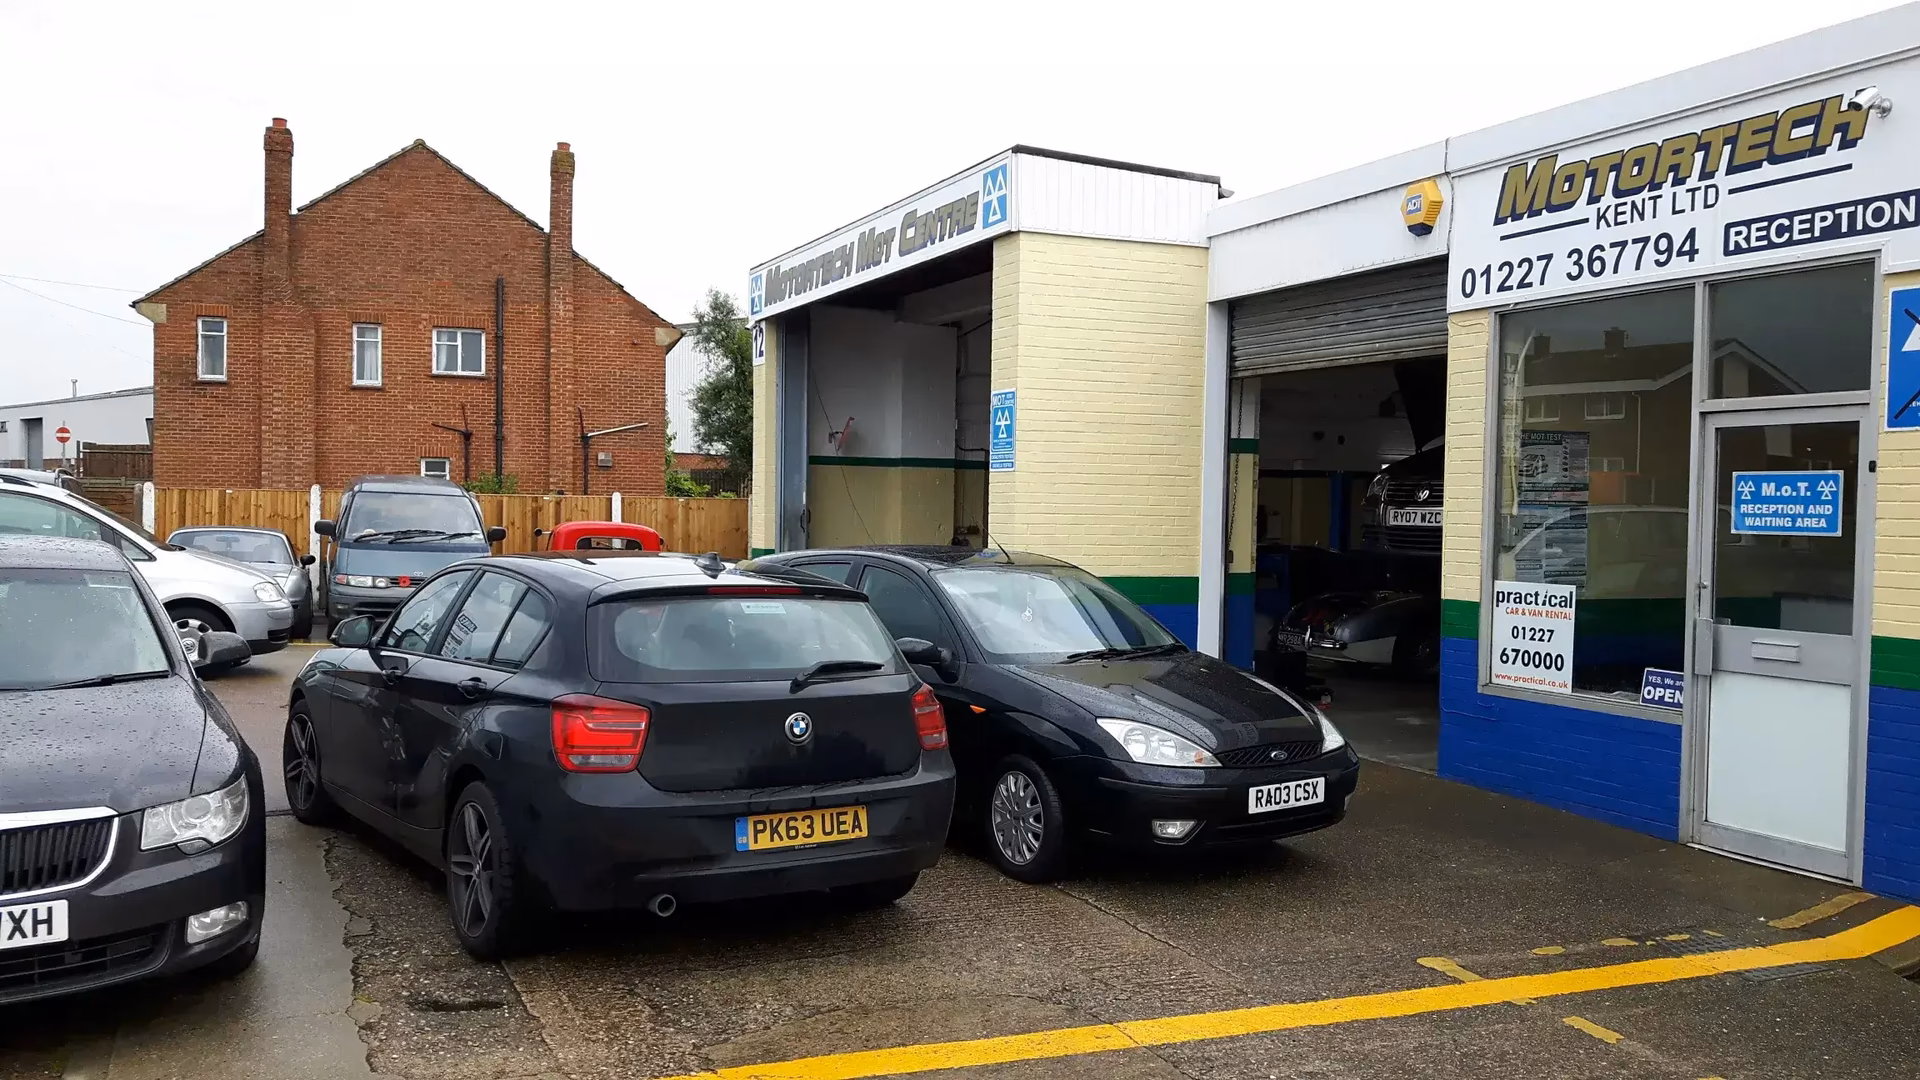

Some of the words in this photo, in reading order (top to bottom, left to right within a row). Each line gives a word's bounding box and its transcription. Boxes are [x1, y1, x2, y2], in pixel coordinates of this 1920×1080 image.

[1595, 194, 1663, 231] KENT
[1671, 182, 1720, 216] LTD
[1728, 196, 1916, 251] RECEPTION
[1461, 253, 1554, 299] 01227
[1565, 227, 1700, 282] 367794
[754, 327, 764, 359] 12
[993, 394, 1005, 406] MOT
[1531, 433, 1545, 441] MOT
[1546, 433, 1562, 441] TEST
[1761, 482, 1811, 497] M.o.T.
[1392, 511, 1417, 523] RY07
[1740, 504, 1804, 514] RECEPTION
[1807, 504, 1833, 515] AND
[1744, 517, 1792, 527] WAITING
[1795, 518, 1827, 528] AREA
[1495, 589, 1573, 608] practical
[1505, 607, 1519, 615] CAR
[1521, 608, 1526, 616] &
[1528, 608, 1543, 617] VAN
[1545, 610, 1572, 620] RENTAL
[1511, 625, 1555, 643] 01227
[1500, 647, 1564, 672] 670000
[1494, 673, 1568, 689] www.practical.co.uk
[1648, 676, 1663, 685] YES,
[1643, 685, 1684, 704] OPEN
[1255, 785, 1291, 808] RA03
[1294, 780, 1319, 802] CSX
[752, 814, 815, 844] PK63
[821, 809, 863, 837] UEA
[0, 906, 53, 941] XH
